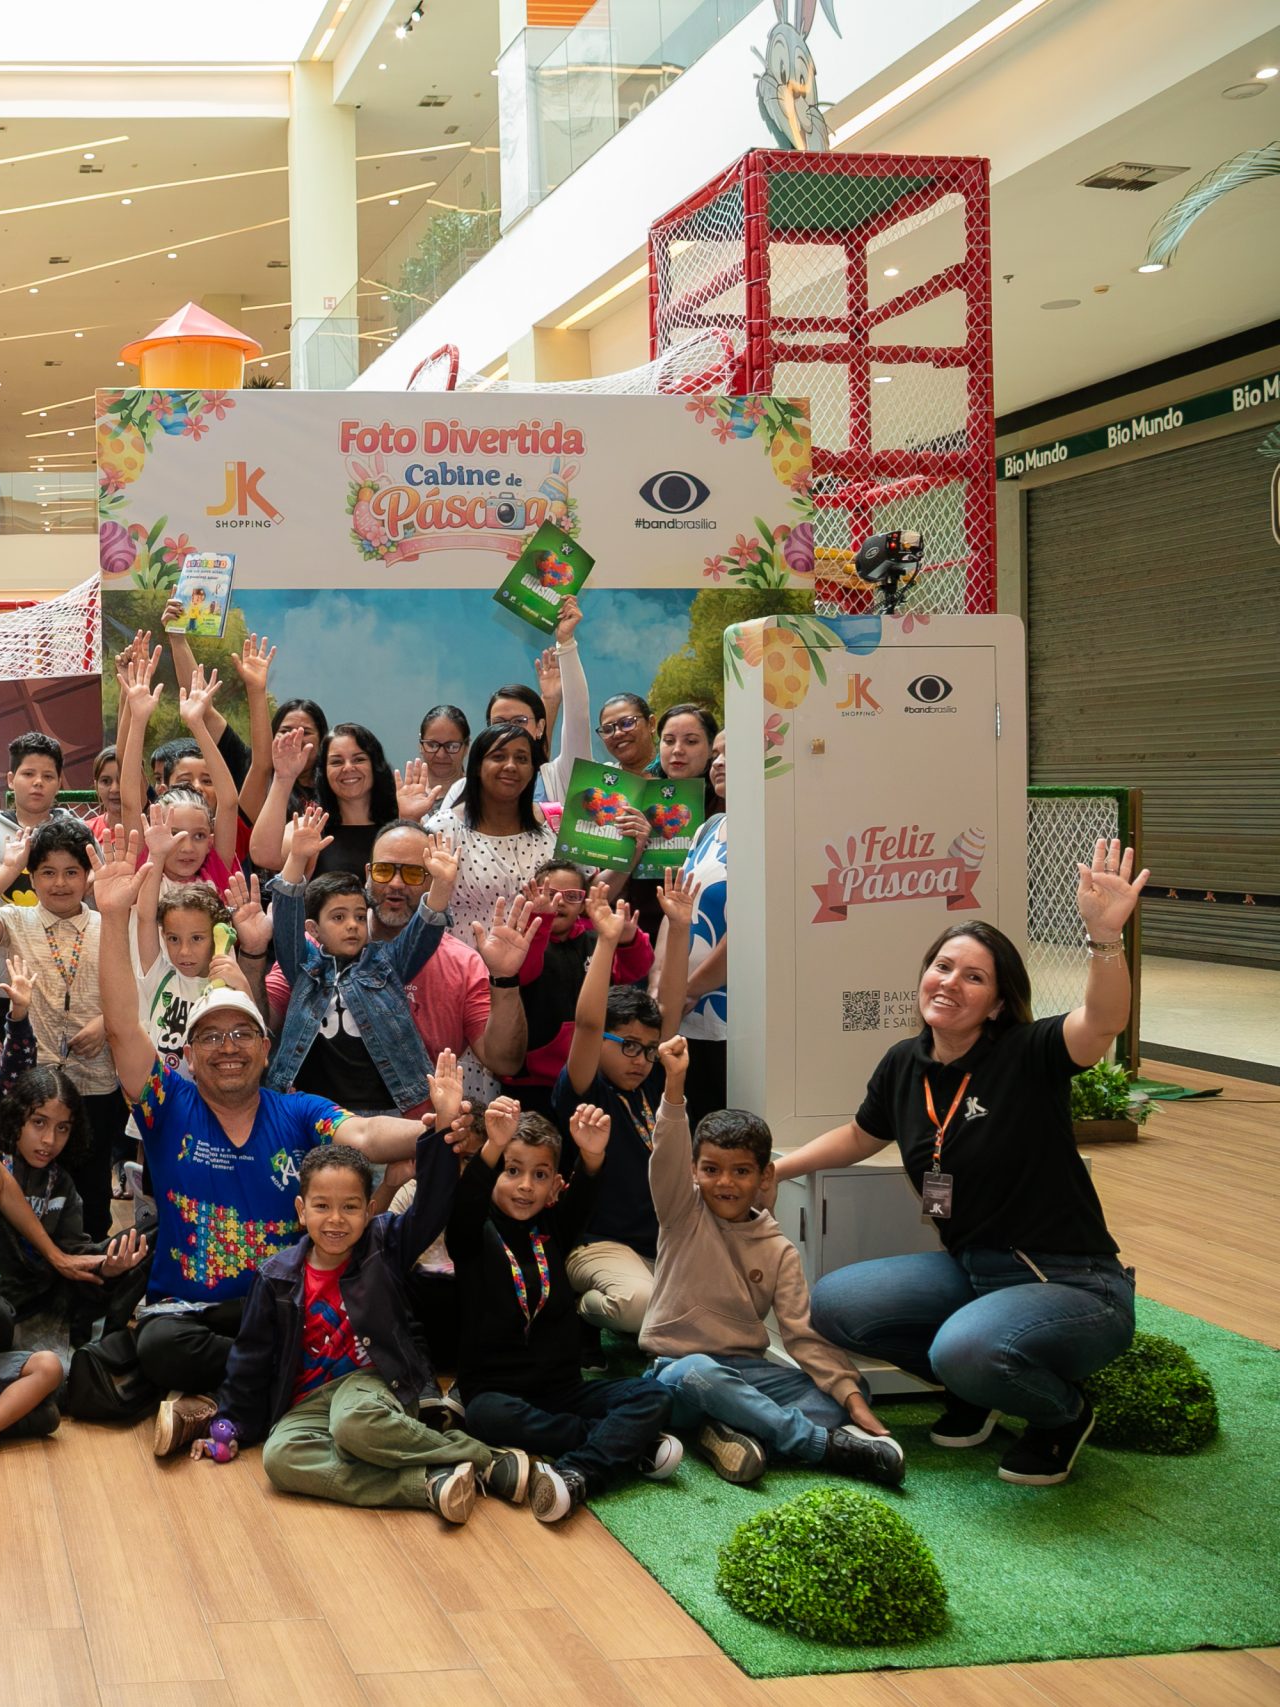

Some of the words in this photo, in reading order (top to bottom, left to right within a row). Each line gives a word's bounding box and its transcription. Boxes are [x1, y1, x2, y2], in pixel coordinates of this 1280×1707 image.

[1233, 387, 1261, 411] Bio
[340, 421, 417, 454] Foto
[423, 420, 585, 454] Divertida
[1108, 426, 1130, 448] Bio
[1132, 408, 1183, 438] Mundo
[404, 461, 501, 487] Cabine
[505, 473, 523, 487] de
[1005, 457, 1023, 477] Bio
[1025, 442, 1068, 470] Mundo
[206, 461, 285, 525] JK
[215, 520, 272, 529] SHOPPING
[836, 673, 884, 714] JK
[861, 825, 936, 862] Feliz
[838, 864, 959, 903] Páscoa
[883, 1005, 895, 1015] JK
[884, 1018, 889, 1029] E
